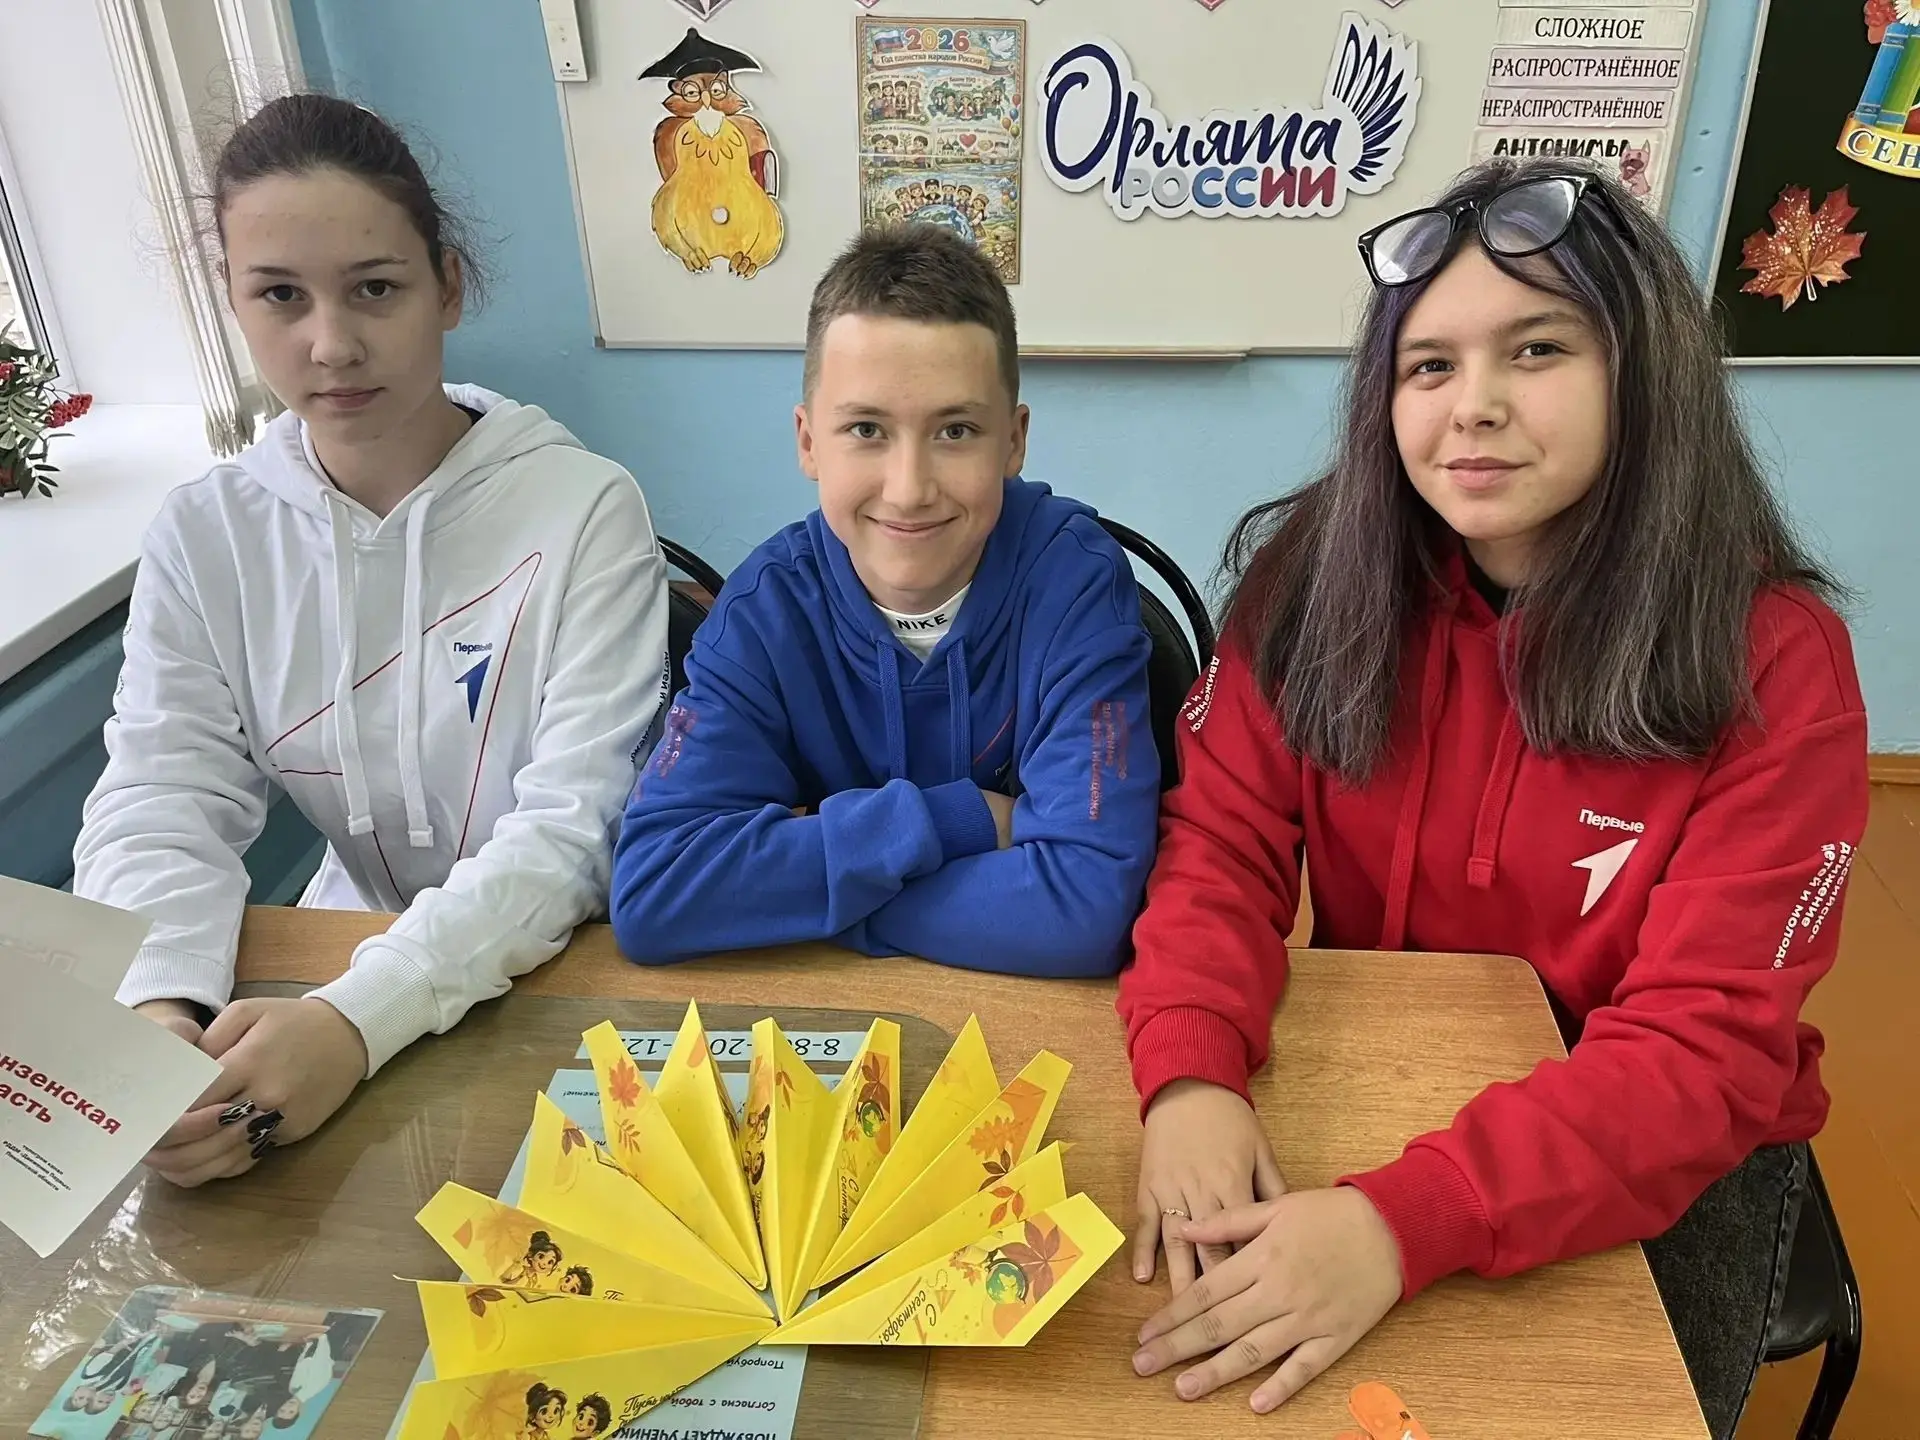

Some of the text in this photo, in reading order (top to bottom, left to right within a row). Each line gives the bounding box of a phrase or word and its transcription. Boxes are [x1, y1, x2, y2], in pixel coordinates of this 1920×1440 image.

[904, 28, 970, 53] 2026
[1535, 17, 1645, 40] СЛОЖНОЕ
[881, 56, 893, 64] Год
[928, 54, 956, 64] народов
[1491, 56, 1681, 79] РАСПРОСТРАНЁННОЕ
[1043, 43, 1342, 193] Орлята
[1482, 97, 1666, 120] НЕРАСПРОСТРАНЁННОЕ
[1493, 138, 1629, 158] АНТОНИМЫ
[1847, 128, 1920, 168] СЕН
[1121, 165, 1336, 208] РОССИИ
[896, 613, 948, 630] NIKE
[453, 642, 493, 655] Первые
[1579, 808, 1645, 833] Первые
[1808, 847, 1857, 943] оссийское
[1771, 904, 1803, 971] молодё
[0, 1054, 121, 1135] нзенская
[721, 1399, 775, 1411] Согласна
